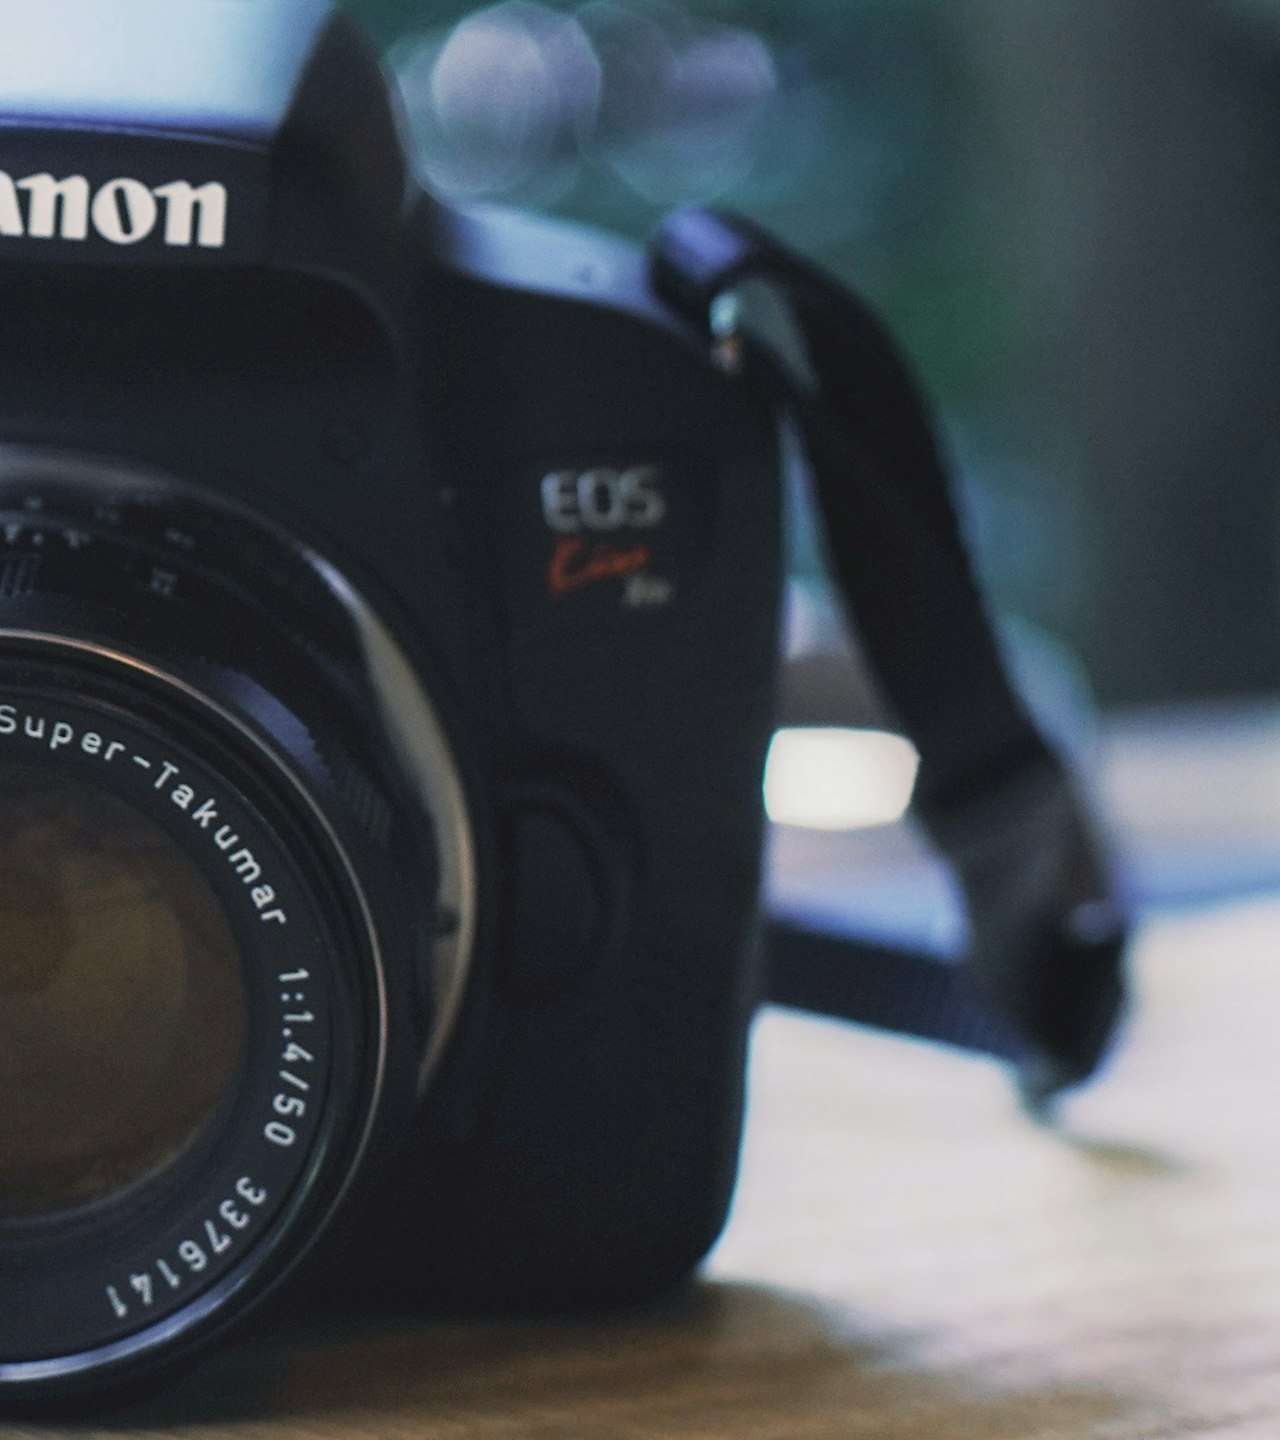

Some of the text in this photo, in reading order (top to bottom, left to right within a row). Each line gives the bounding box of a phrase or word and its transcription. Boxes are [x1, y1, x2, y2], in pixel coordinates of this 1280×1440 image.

[541, 466, 666, 533] EOS
[263, 965, 315, 1148] 1:1.4/50
[105, 1174, 268, 1319] 3376141
